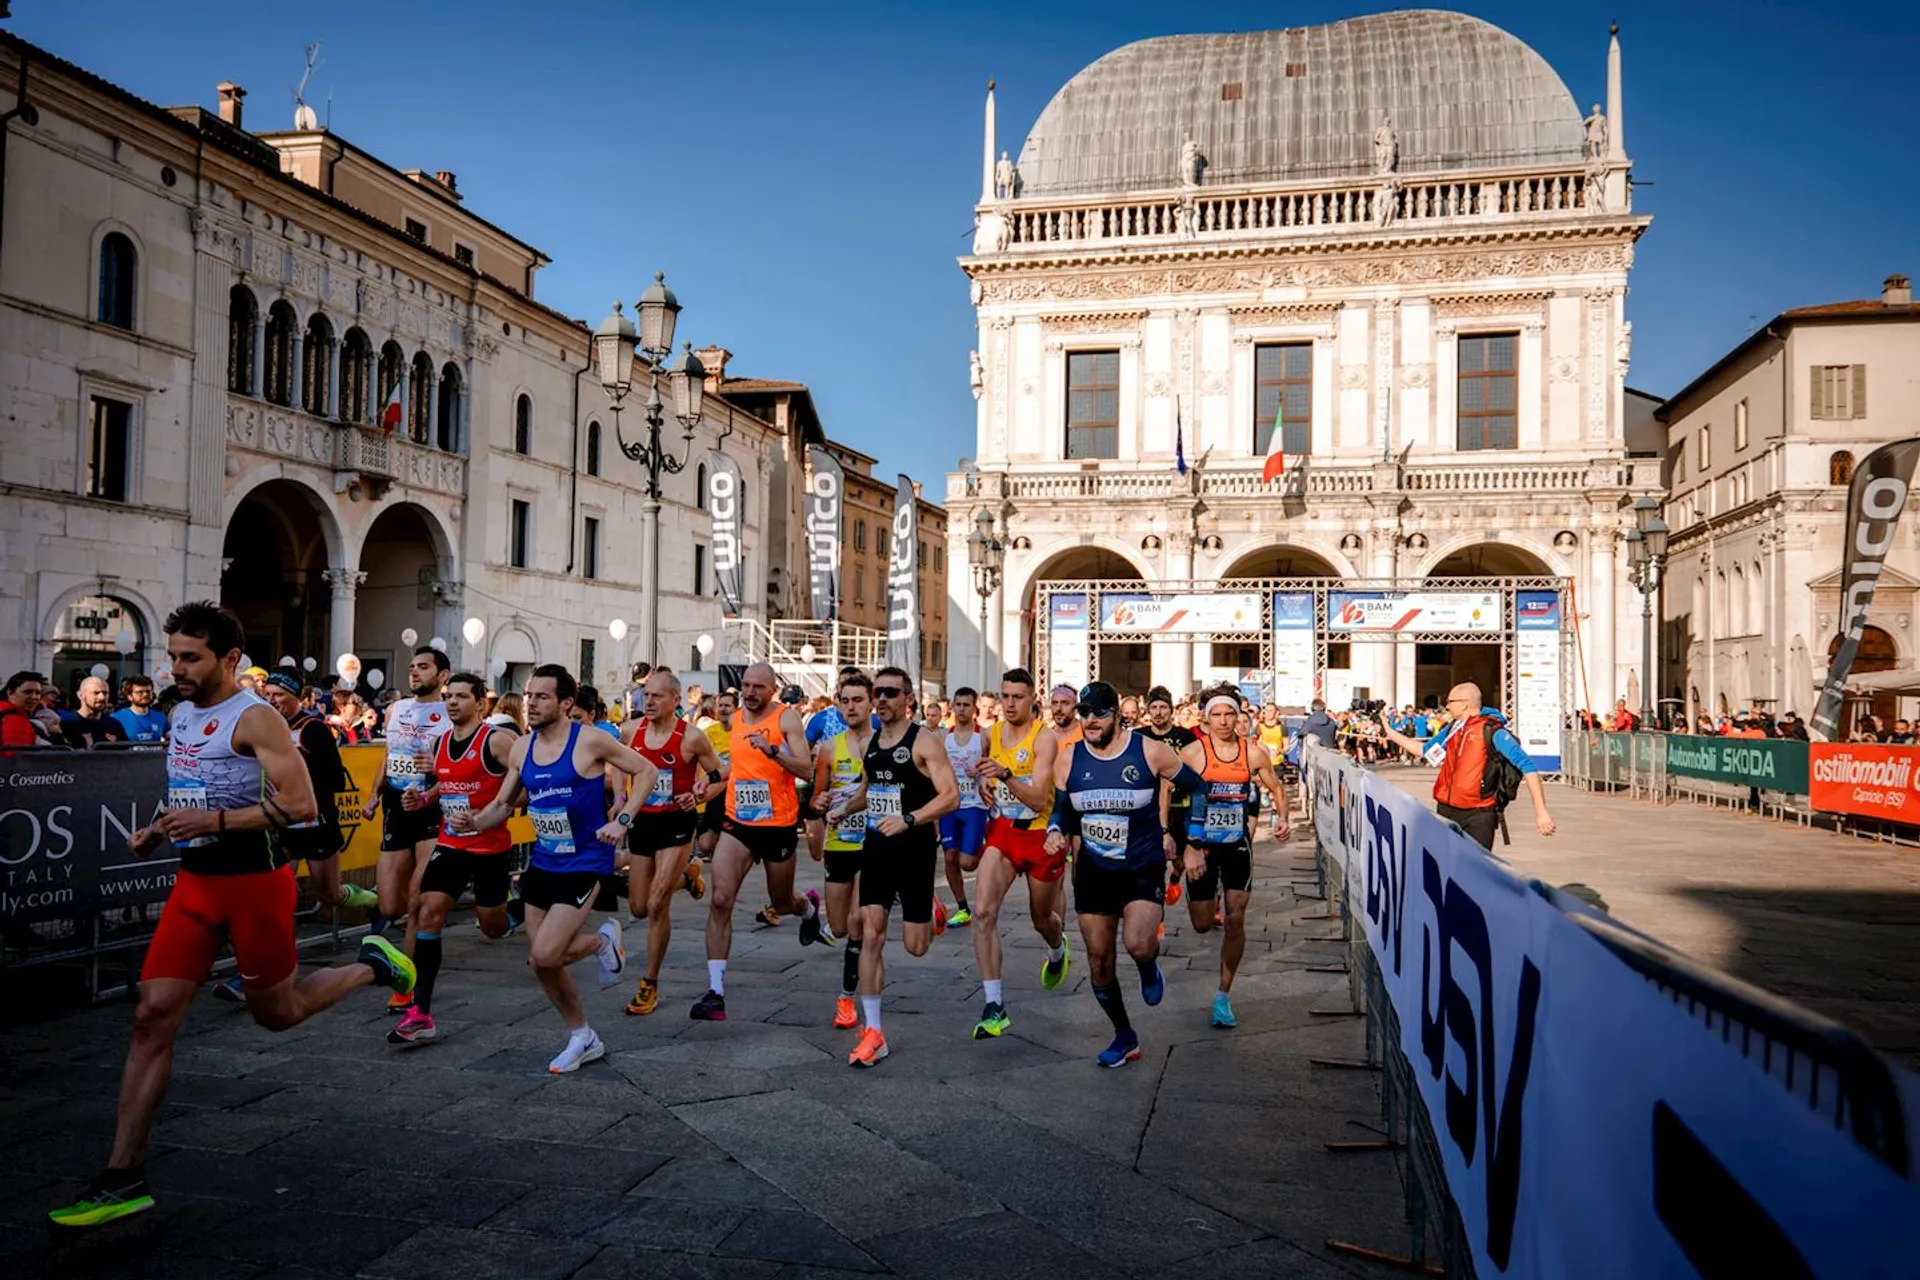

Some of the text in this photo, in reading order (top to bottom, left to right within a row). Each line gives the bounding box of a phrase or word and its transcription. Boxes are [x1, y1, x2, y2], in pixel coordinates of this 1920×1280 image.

[1137, 604, 1161, 613] BAM
[1367, 603, 1393, 611] BAM
[1668, 743, 1717, 772] Automobili
[1722, 747, 1776, 779] SKODA
[9, 770, 75, 787] Cosmetics
[1814, 753, 1912, 789] ostiliomobili
[740, 790, 765, 803] 5180
[870, 798, 894, 813] 5571
[1081, 800, 1134, 809] TRIATHLON
[1209, 813, 1236, 826] 5243
[1089, 825, 1120, 841] 6024
[1421, 846, 1541, 1273] DSV
